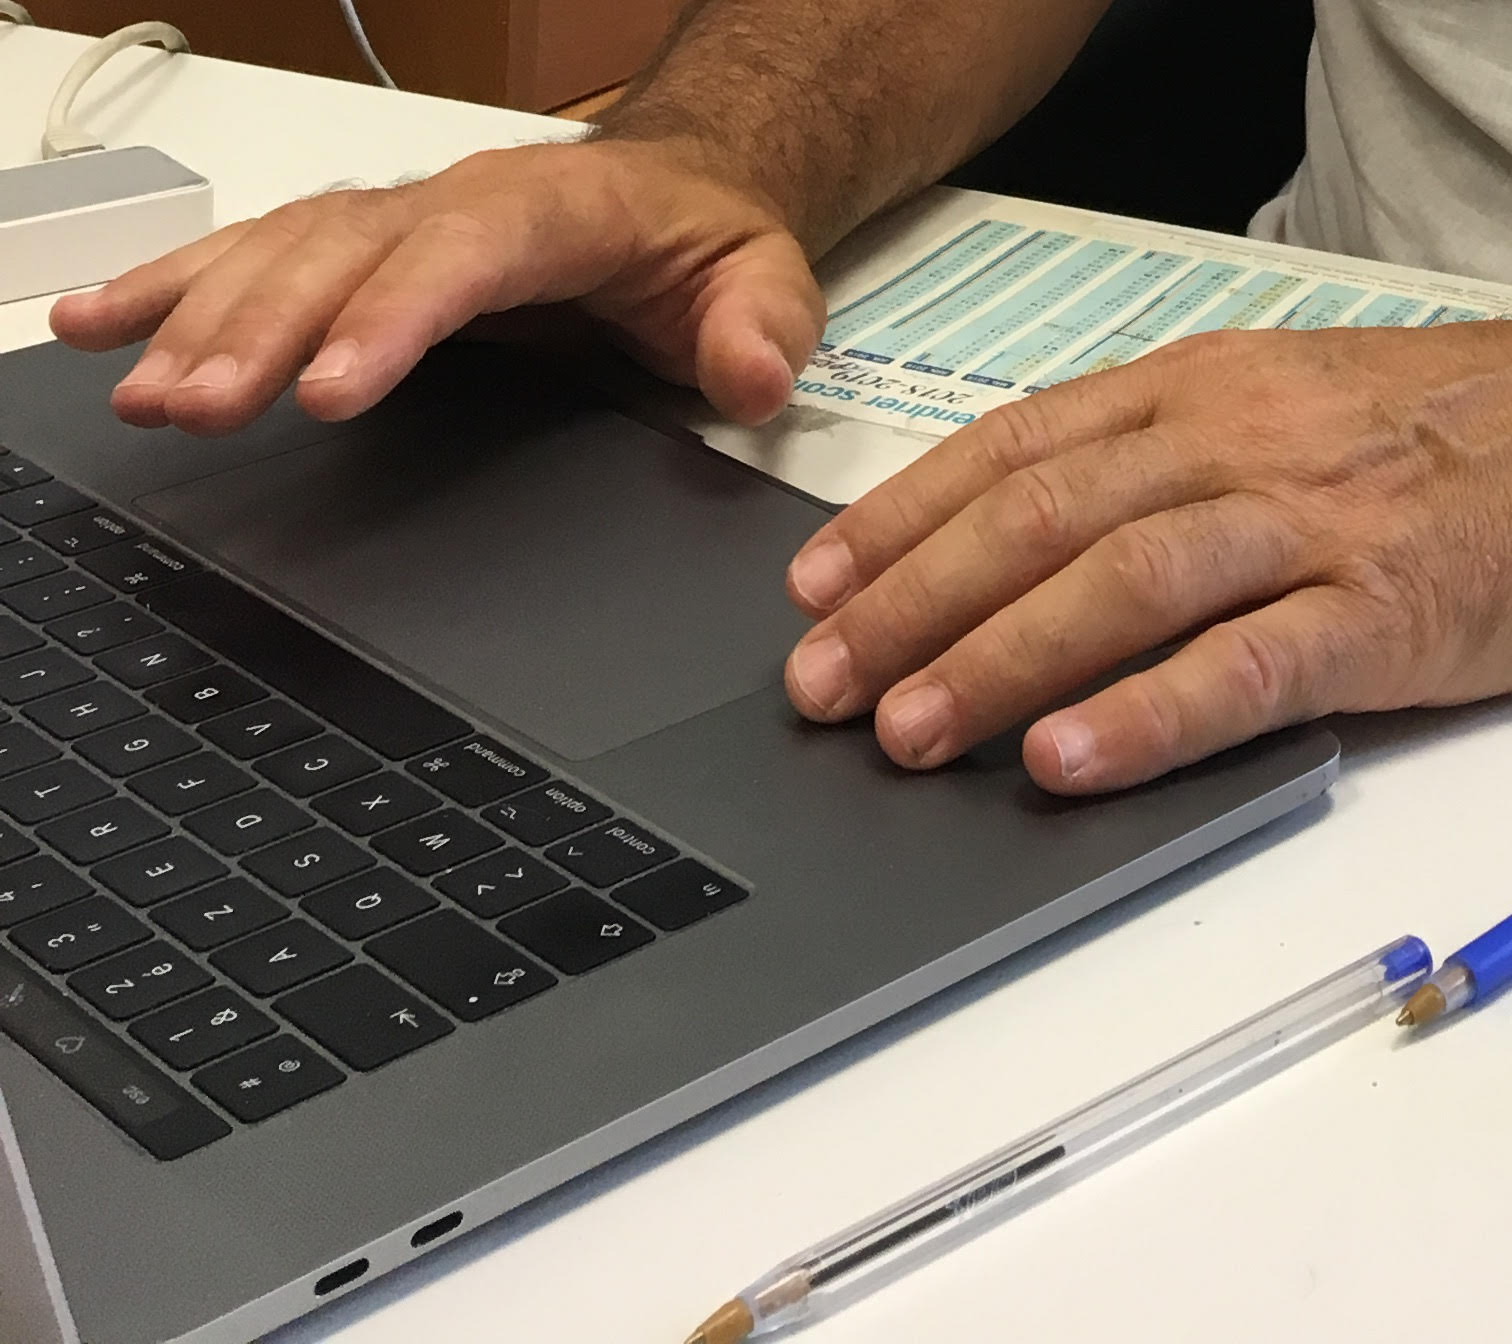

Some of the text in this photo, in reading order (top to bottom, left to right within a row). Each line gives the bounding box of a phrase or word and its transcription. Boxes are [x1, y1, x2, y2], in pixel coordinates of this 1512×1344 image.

[860, 395, 977, 424] endrier
[141, 653, 168, 667] N
[19, 669, 46, 679] J
[194, 687, 220, 700] B
[70, 702, 99, 717] H
[245, 723, 272, 736] V
[124, 739, 150, 752] G
[304, 758, 329, 771] C
[463, 742, 527, 778] command
[34, 785, 61, 798] T
[177, 779, 206, 790] F
[361, 794, 390, 811] X
[545, 787, 588, 814] option
[235, 814, 263, 829] D
[89, 822, 118, 837] R
[419, 833, 451, 851] W
[604, 825, 656, 856] control
[294, 853, 320, 868] S
[145, 862, 175, 877] E
[702, 883, 722, 897] fn
[355, 892, 382, 910] Q
[203, 904, 234, 921] Z
[47, 933, 76, 948] 3
[268, 947, 297, 963] A
[105, 978, 135, 994] 2
[169, 1028, 194, 1042] 1
